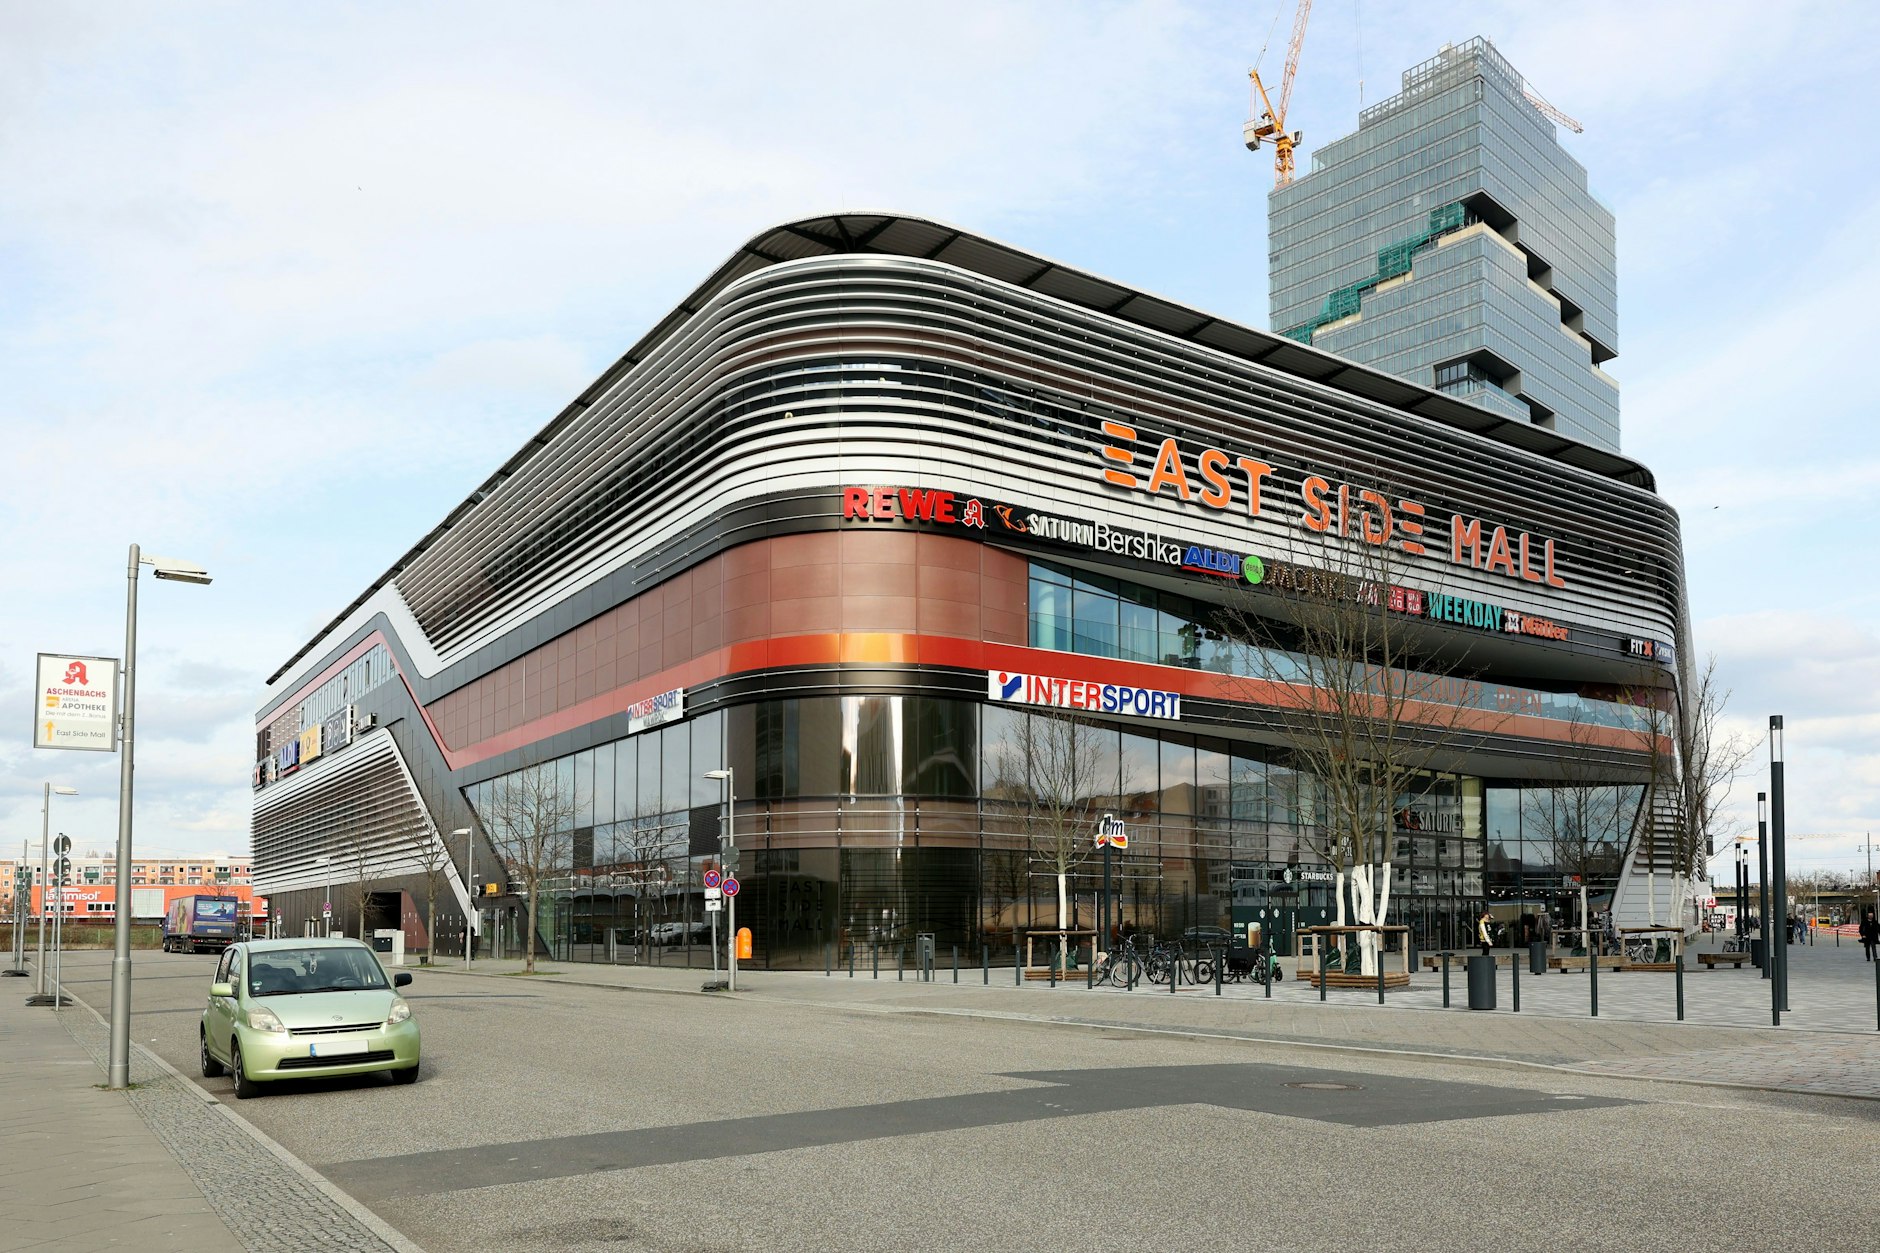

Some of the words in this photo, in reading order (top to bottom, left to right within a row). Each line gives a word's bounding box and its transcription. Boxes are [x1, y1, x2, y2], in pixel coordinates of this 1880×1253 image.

[844, 487, 955, 523] REWE
[1101, 421, 1272, 516] EAST
[1302, 476, 1426, 555] SIDE
[1451, 515, 1565, 588] MALL
[1028, 513, 1094, 547] SATURN
[1094, 521, 1182, 566] Bershka
[1182, 546, 1240, 575] ALDI
[1428, 592, 1501, 630] WEEKDAY
[1521, 615, 1568, 640] Müller
[46, 687, 107, 698] ASCHENBACHS
[61, 702, 106, 711] APOTHEKE
[632, 690, 678, 719] INTERSPORT
[1026, 675, 1180, 718] INTERSPORT
[1496, 687, 1542, 714] OPEN
[56, 729, 71, 737] East
[72, 730, 89, 738] Side
[90, 731, 106, 739] Mall
[1419, 810, 1455, 833] SATURN
[778, 881, 825, 893] EAST
[1300, 872, 1334, 881] STARBUCKS
